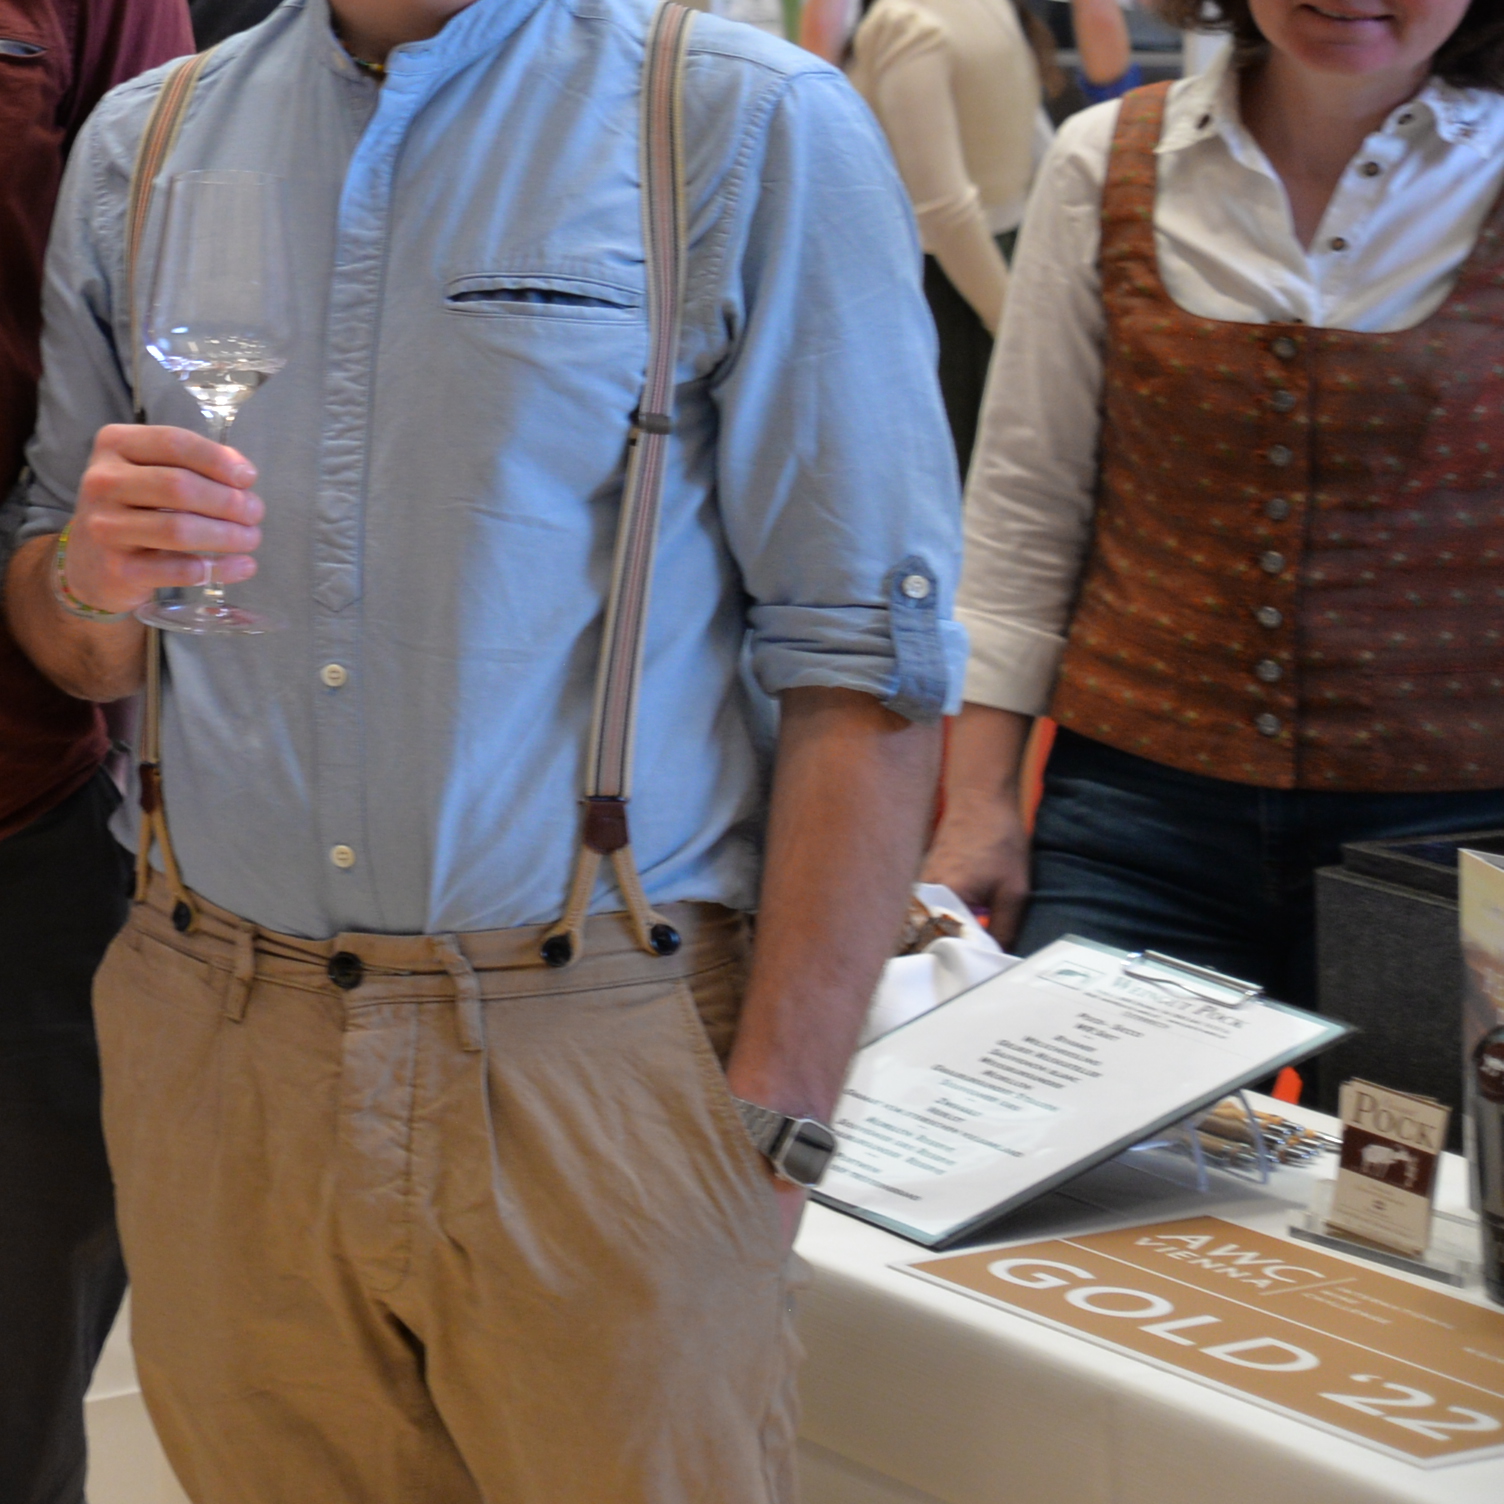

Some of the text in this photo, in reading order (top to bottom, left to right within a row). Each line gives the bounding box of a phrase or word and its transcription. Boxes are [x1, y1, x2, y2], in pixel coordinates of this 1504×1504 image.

[1350, 1089, 1438, 1149] POCK
[1134, 1236, 1274, 1290] VIENNA
[1155, 1234, 1326, 1284] AWC
[987, 1257, 1321, 1372] GOLD
